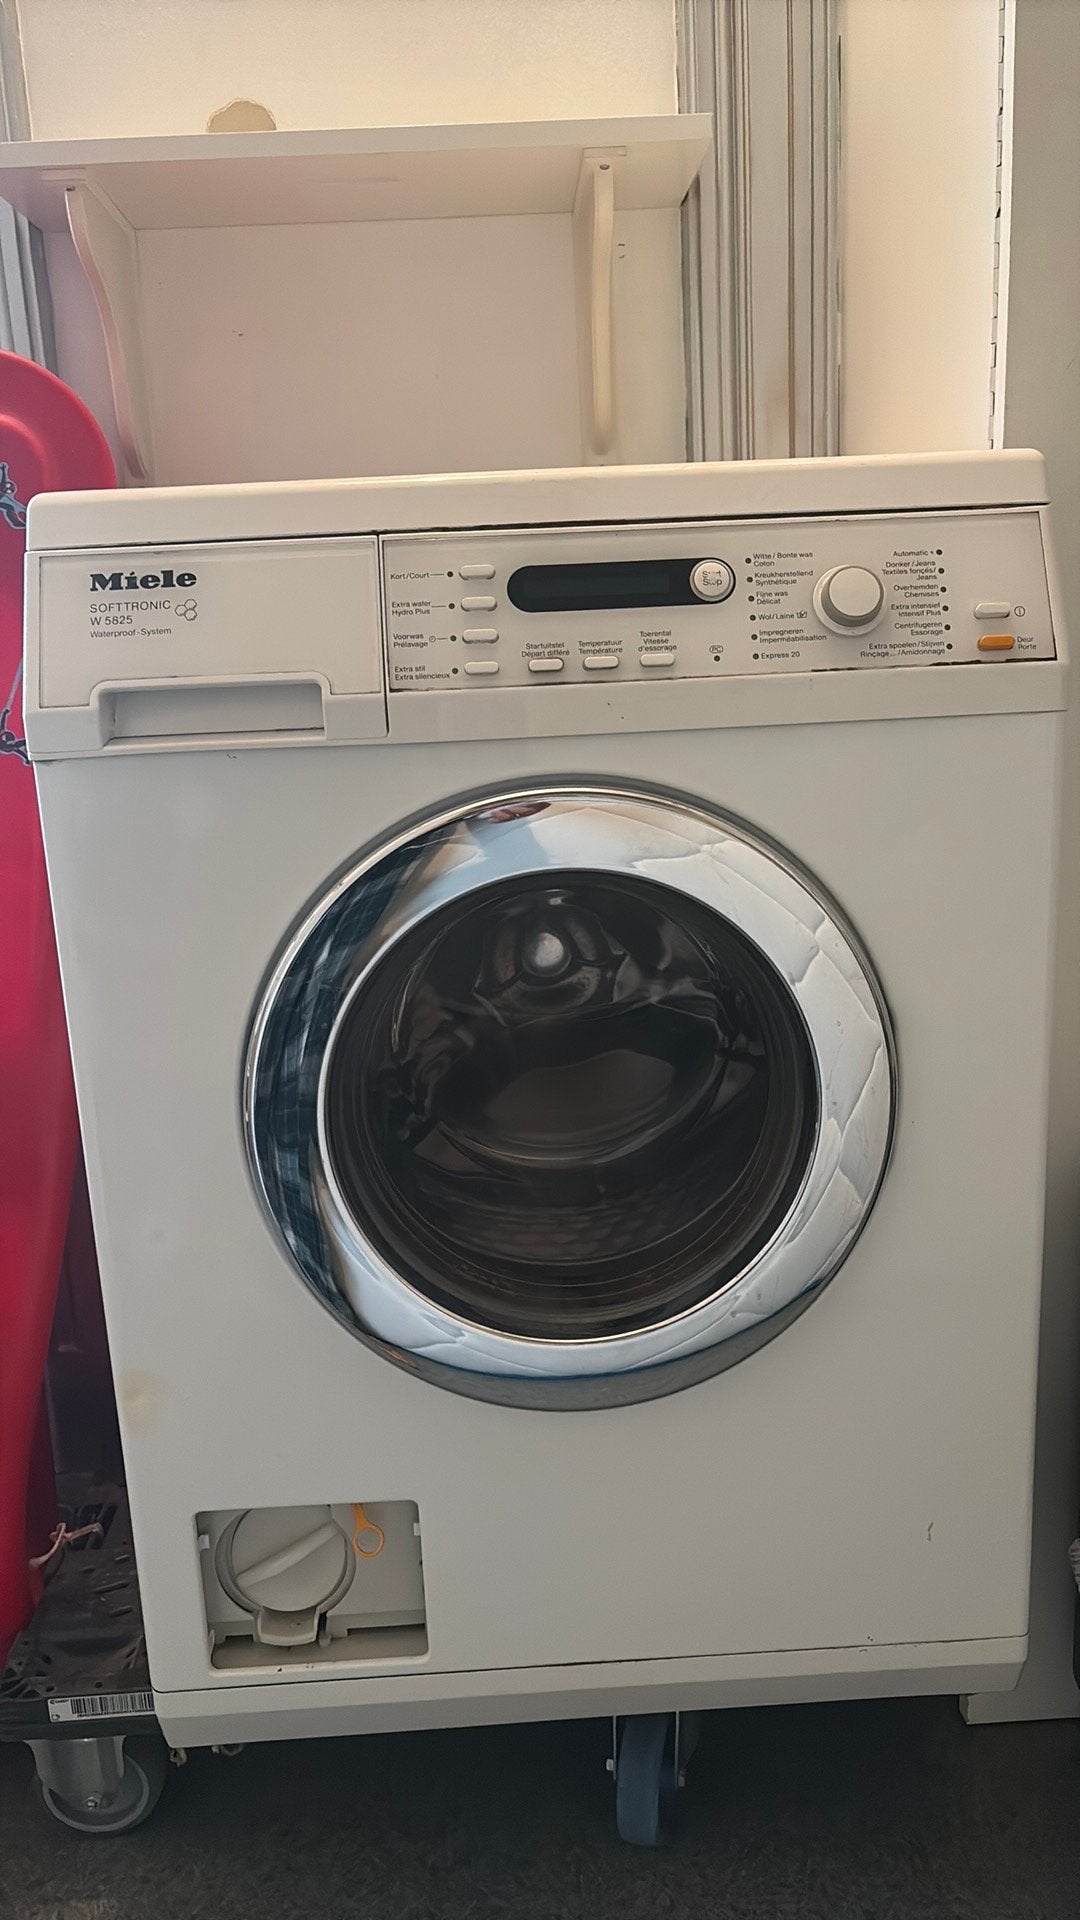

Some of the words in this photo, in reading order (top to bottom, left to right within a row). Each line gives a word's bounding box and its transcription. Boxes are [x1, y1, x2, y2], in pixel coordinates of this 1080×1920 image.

[390, 572, 430, 580] Kort/Court
[754, 570, 814, 578] Kreukherstellend
[90, 570, 197, 592] Miele
[756, 578, 797, 587] Synthétique
[90, 600, 171, 613] SOFTTRONIC
[90, 616, 102, 626] W
[104, 616, 132, 626] 5825
[759, 628, 804, 636] Impregneren
[760, 634, 826, 644] Imperméabilisation
[526, 642, 564, 650] Startuitstel
[578, 640, 622, 648] Temperatuur
[522, 650, 546, 658] Départ
[578, 647, 622, 655] Température
